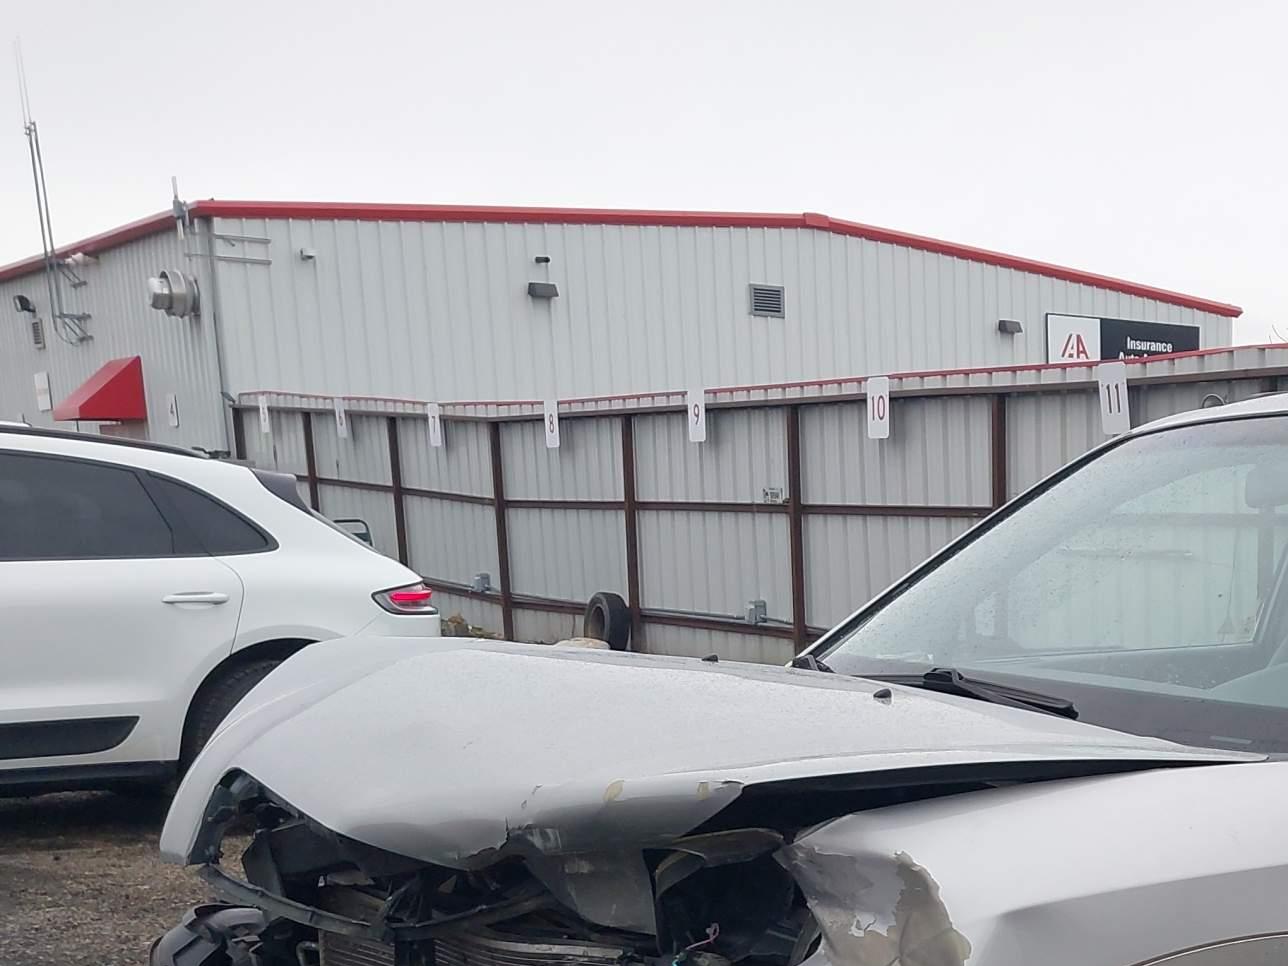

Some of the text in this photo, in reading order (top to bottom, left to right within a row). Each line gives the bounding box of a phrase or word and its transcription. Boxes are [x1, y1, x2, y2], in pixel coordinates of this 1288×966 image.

[1126, 336, 1173, 353] Insurance
[871, 394, 886, 421] 10
[1105, 383, 1121, 414] 11
[430, 415, 437, 433] 7
[548, 414, 555, 433] 8
[693, 403, 700, 425] 9
